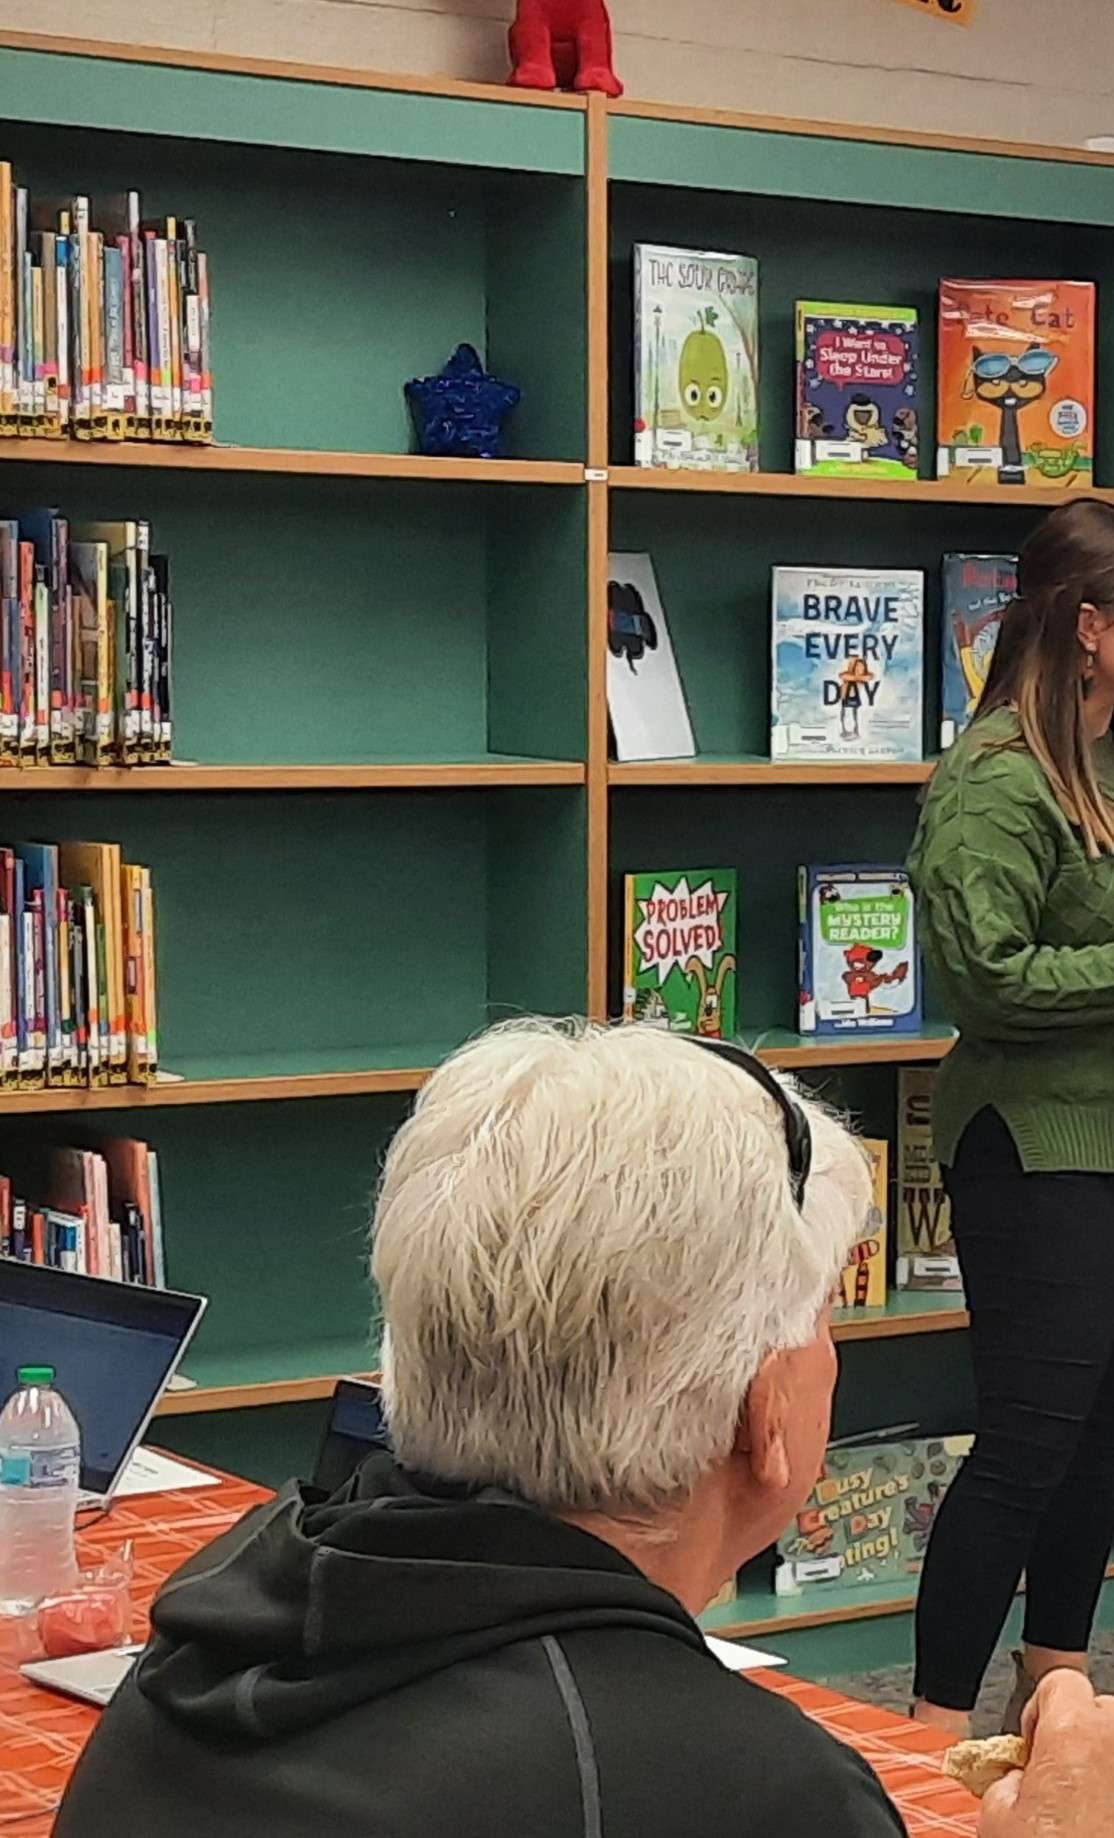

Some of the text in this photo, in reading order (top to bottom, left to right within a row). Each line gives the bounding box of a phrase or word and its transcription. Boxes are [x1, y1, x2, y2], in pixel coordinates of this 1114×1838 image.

[678, 264, 713, 290] SOUR
[1030, 303, 1075, 328] Cat
[820, 347, 902, 365] Sleep Under
[803, 593, 900, 623] BRAVE
[805, 632, 898, 660] EVERY
[823, 680, 880, 706] DAY
[646, 894, 719, 927] PROBLEM
[828, 912, 901, 926] MYSTERY
[829, 927, 899, 940] READER?
